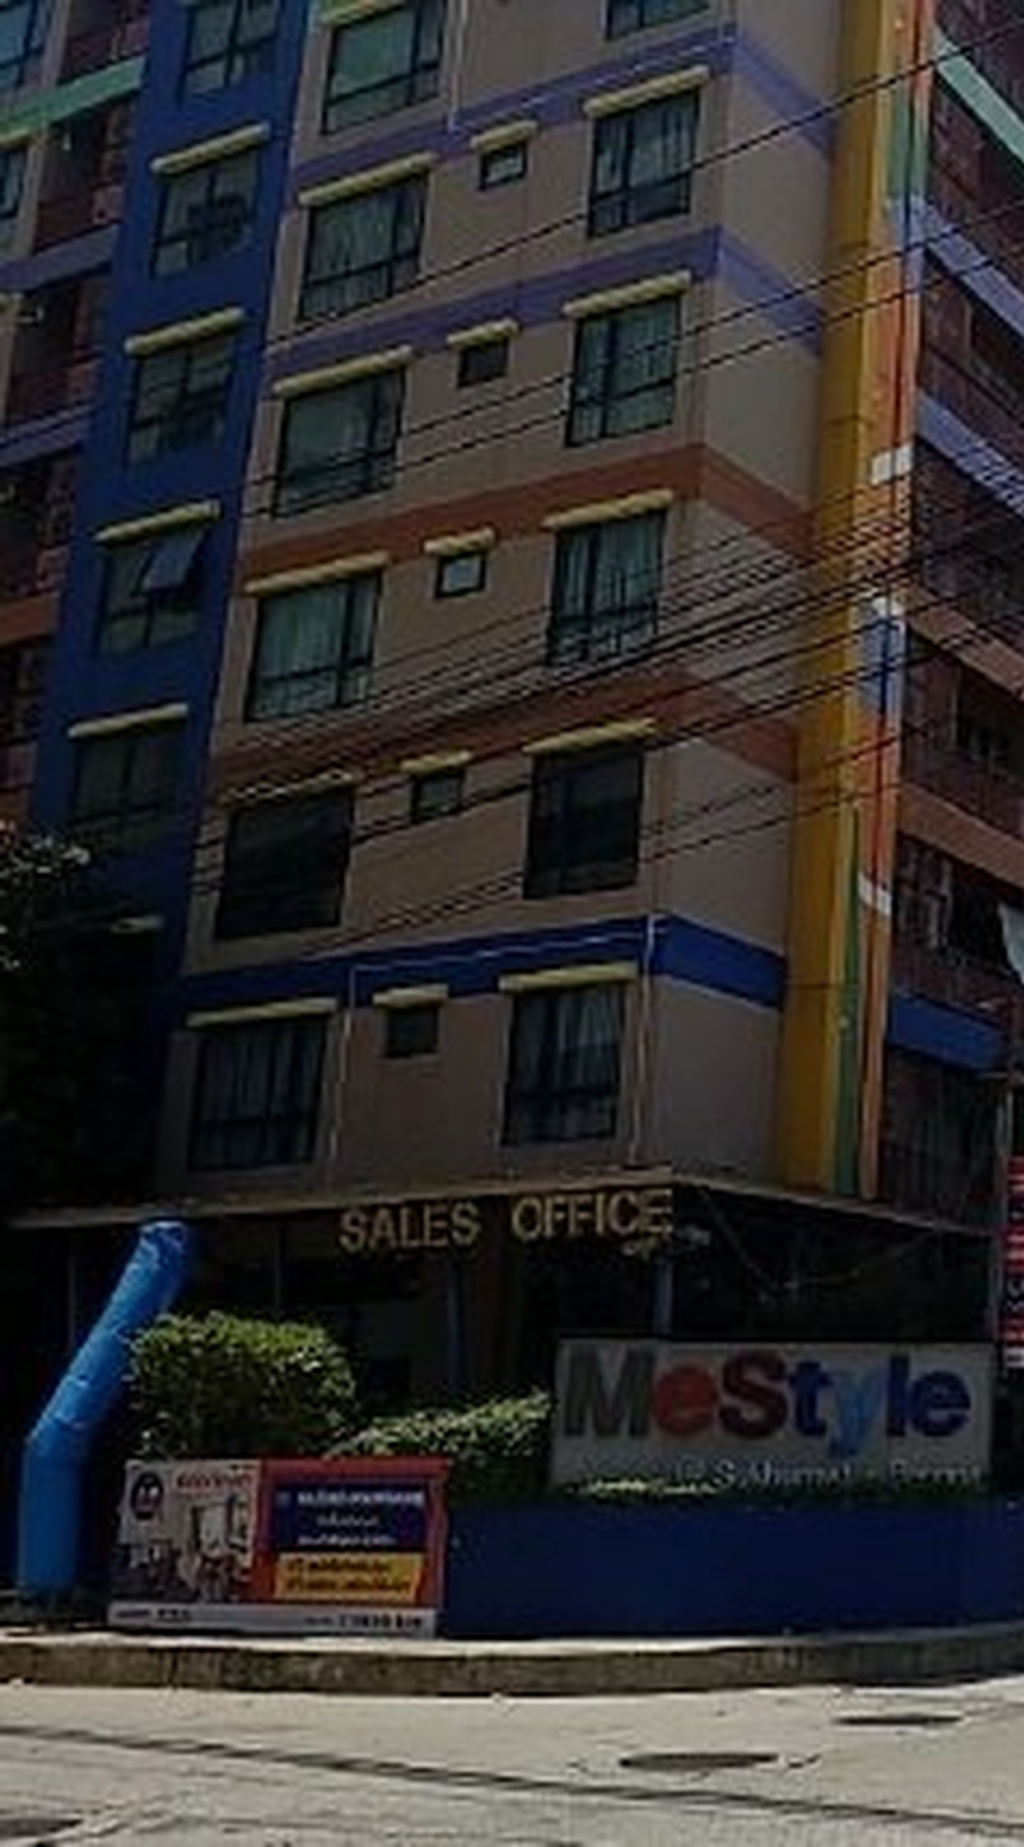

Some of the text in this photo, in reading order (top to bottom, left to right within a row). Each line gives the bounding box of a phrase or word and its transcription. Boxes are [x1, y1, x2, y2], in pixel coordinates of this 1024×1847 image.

[337, 1187, 674, 1253] SALES OFFICE
[565, 1346, 970, 1456] MeStyle
